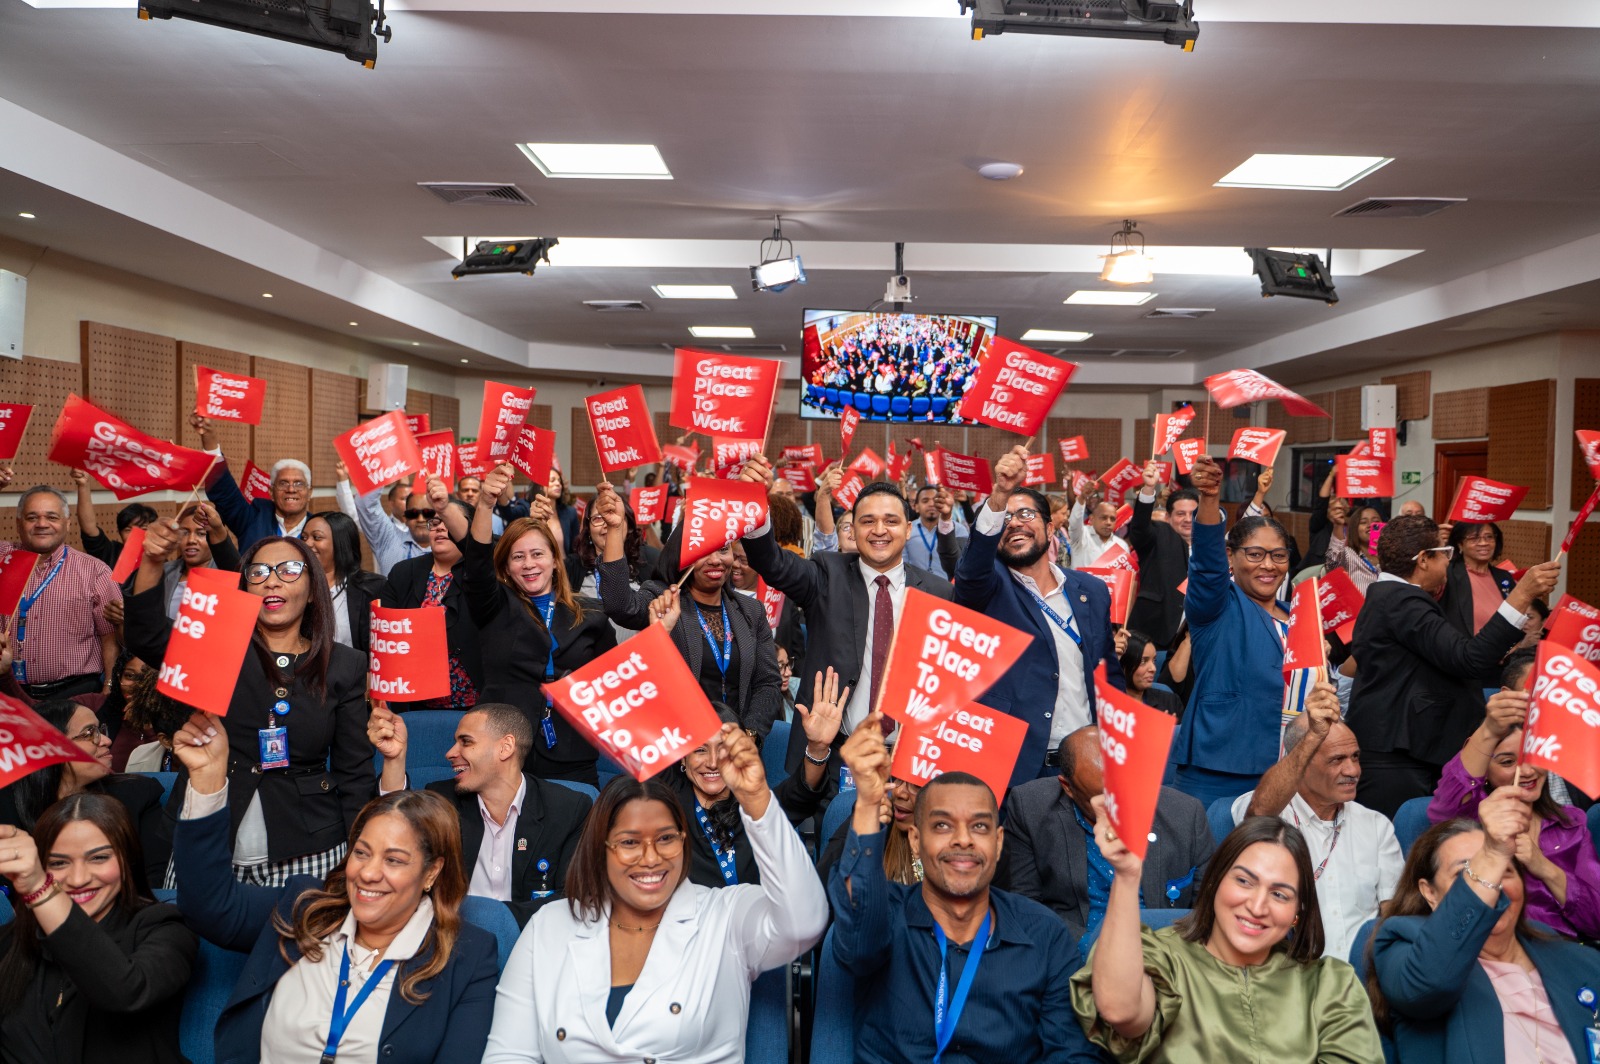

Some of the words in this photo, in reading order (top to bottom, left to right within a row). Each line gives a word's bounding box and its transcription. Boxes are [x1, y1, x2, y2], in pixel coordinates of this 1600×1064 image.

[697, 359, 755, 380] Great
[1006, 351, 1057, 380] Great
[209, 383, 246, 399] Place
[211, 373, 249, 389] Great
[695, 377, 748, 397] Place
[996, 367, 1044, 395] Place
[208, 393, 223, 406] To
[693, 394, 714, 412] To
[990, 384, 1010, 403] To
[592, 396, 628, 416] Great
[350, 420, 395, 448] Great
[495, 425, 507, 440] To
[596, 416, 631, 432] Place
[1241, 429, 1271, 438] Great
[94, 421, 175, 468] Great
[355, 435, 398, 461] Place
[599, 434, 616, 448] To
[1166, 434, 1176, 443] To
[1239, 435, 1266, 445] Place
[85, 449, 117, 466] To
[87, 436, 161, 479] Place
[361, 458, 381, 472] To
[604, 446, 643, 465] Work.
[942, 452, 976, 467] Great
[1346, 458, 1381, 467] Great
[944, 461, 976, 475] Place
[946, 470, 960, 480] To
[1346, 467, 1380, 476] Place
[1346, 476, 1361, 485] To
[1471, 480, 1513, 497] Great
[1466, 499, 1482, 511] To
[1468, 489, 1506, 505] Place
[709, 499, 726, 520] To
[689, 498, 711, 551] Work.
[725, 500, 744, 546] Plac
[182, 587, 218, 615] eat
[1568, 601, 1599, 619] Great
[370, 631, 411, 654] Place
[929, 608, 1000, 659] Great
[921, 635, 981, 682] Place
[159, 662, 190, 691] ork.
[569, 651, 648, 706] Great
[917, 662, 940, 694] To
[581, 681, 658, 731] Place
[948, 710, 994, 735] reat
[598, 728, 632, 752] To
[935, 720, 983, 753] lace
[917, 736, 941, 761] To
[936, 970, 946, 1025] DOMINICANA
